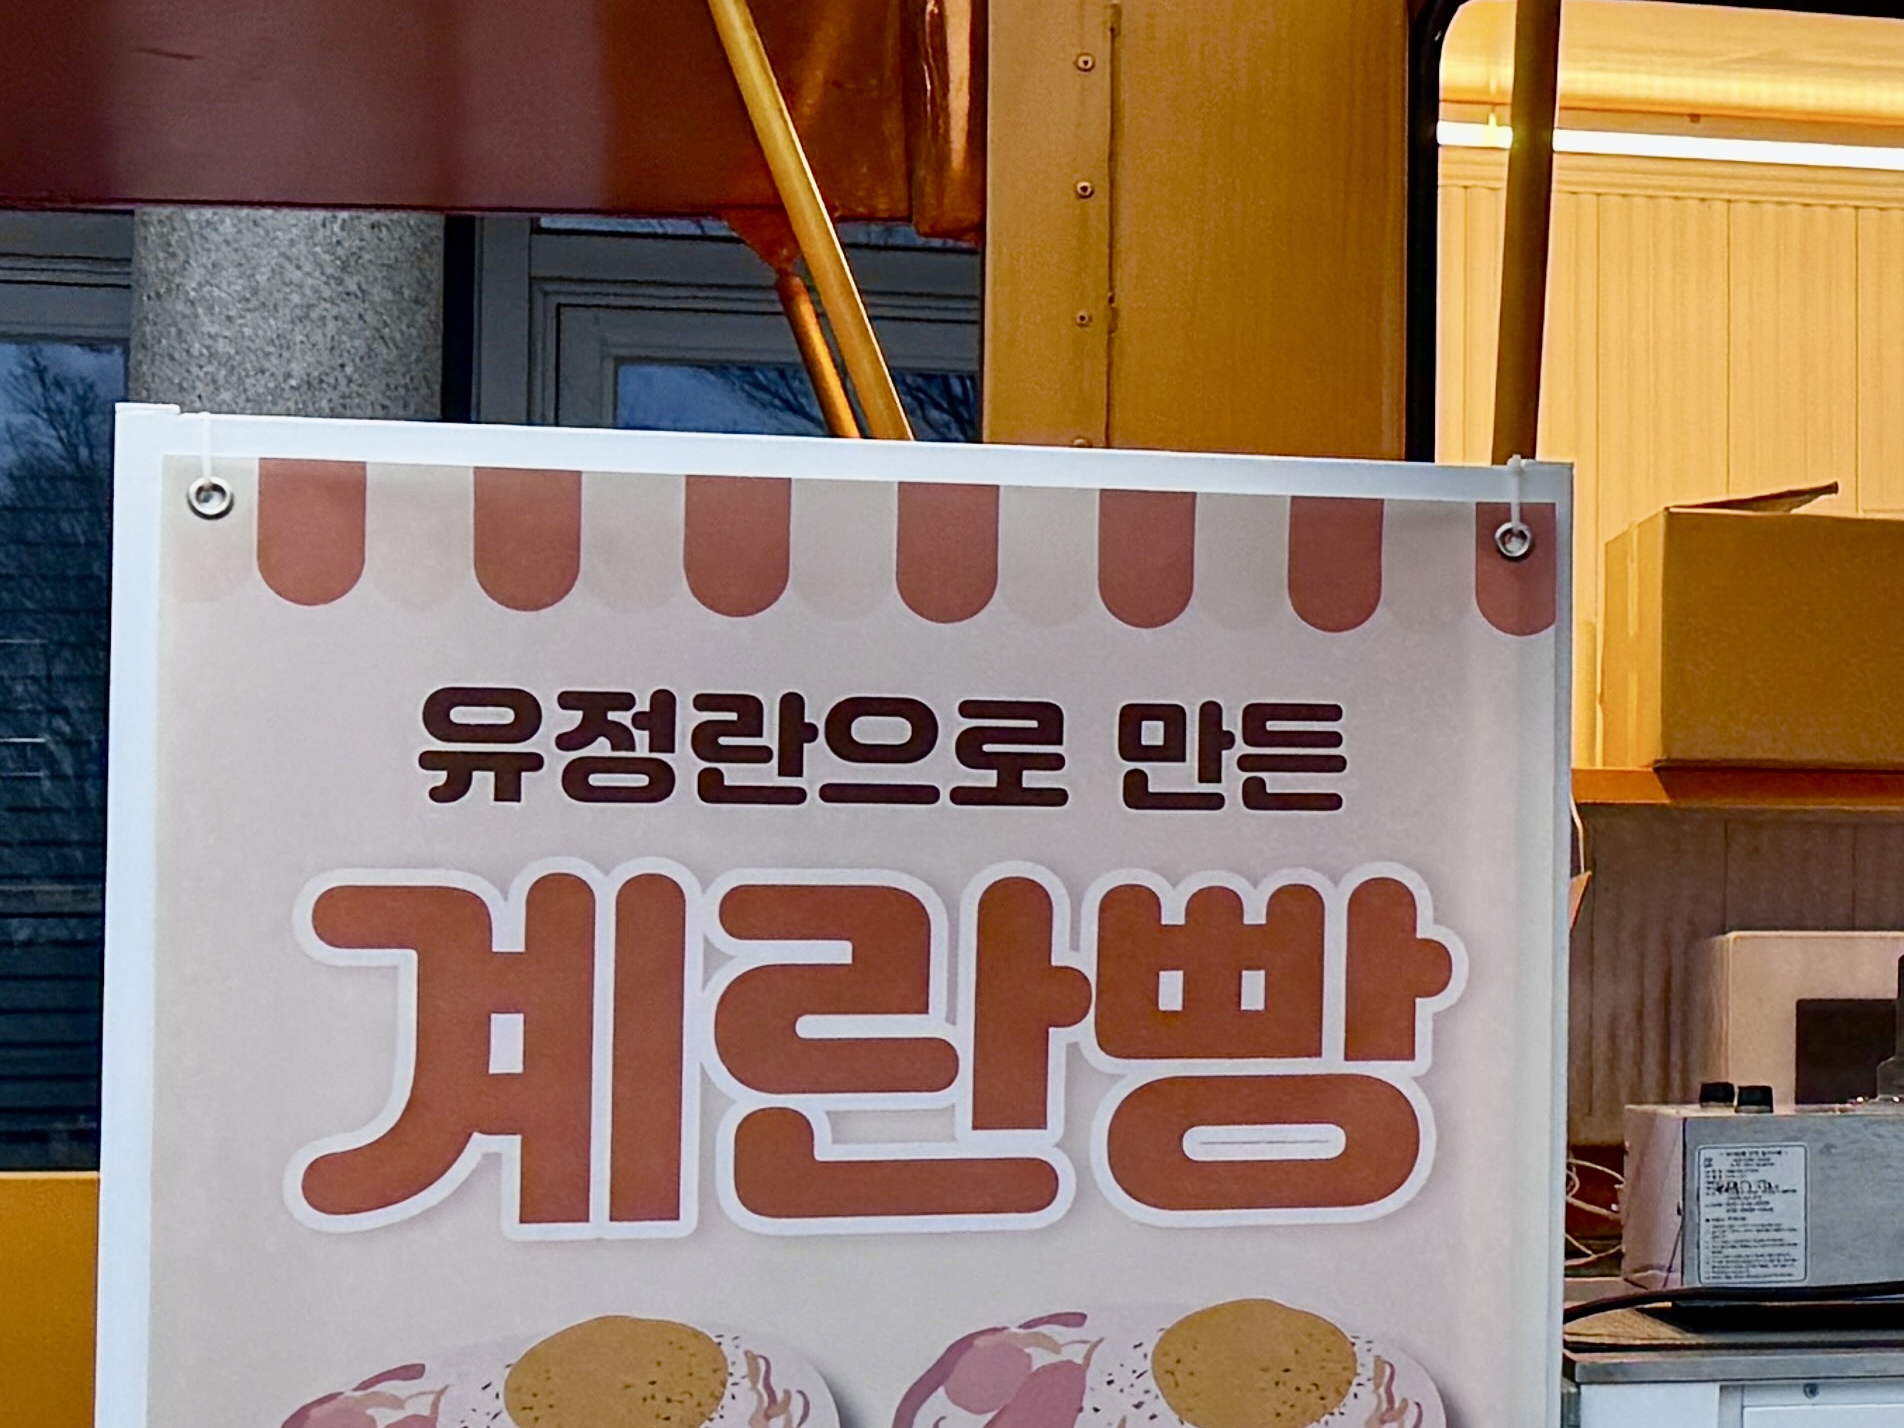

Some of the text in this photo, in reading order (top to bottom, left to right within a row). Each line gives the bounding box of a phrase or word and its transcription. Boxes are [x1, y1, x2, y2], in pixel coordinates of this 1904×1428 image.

[418, 686, 1348, 812] 유정란으로 만든
[296, 870, 1458, 1228] 계란빵
